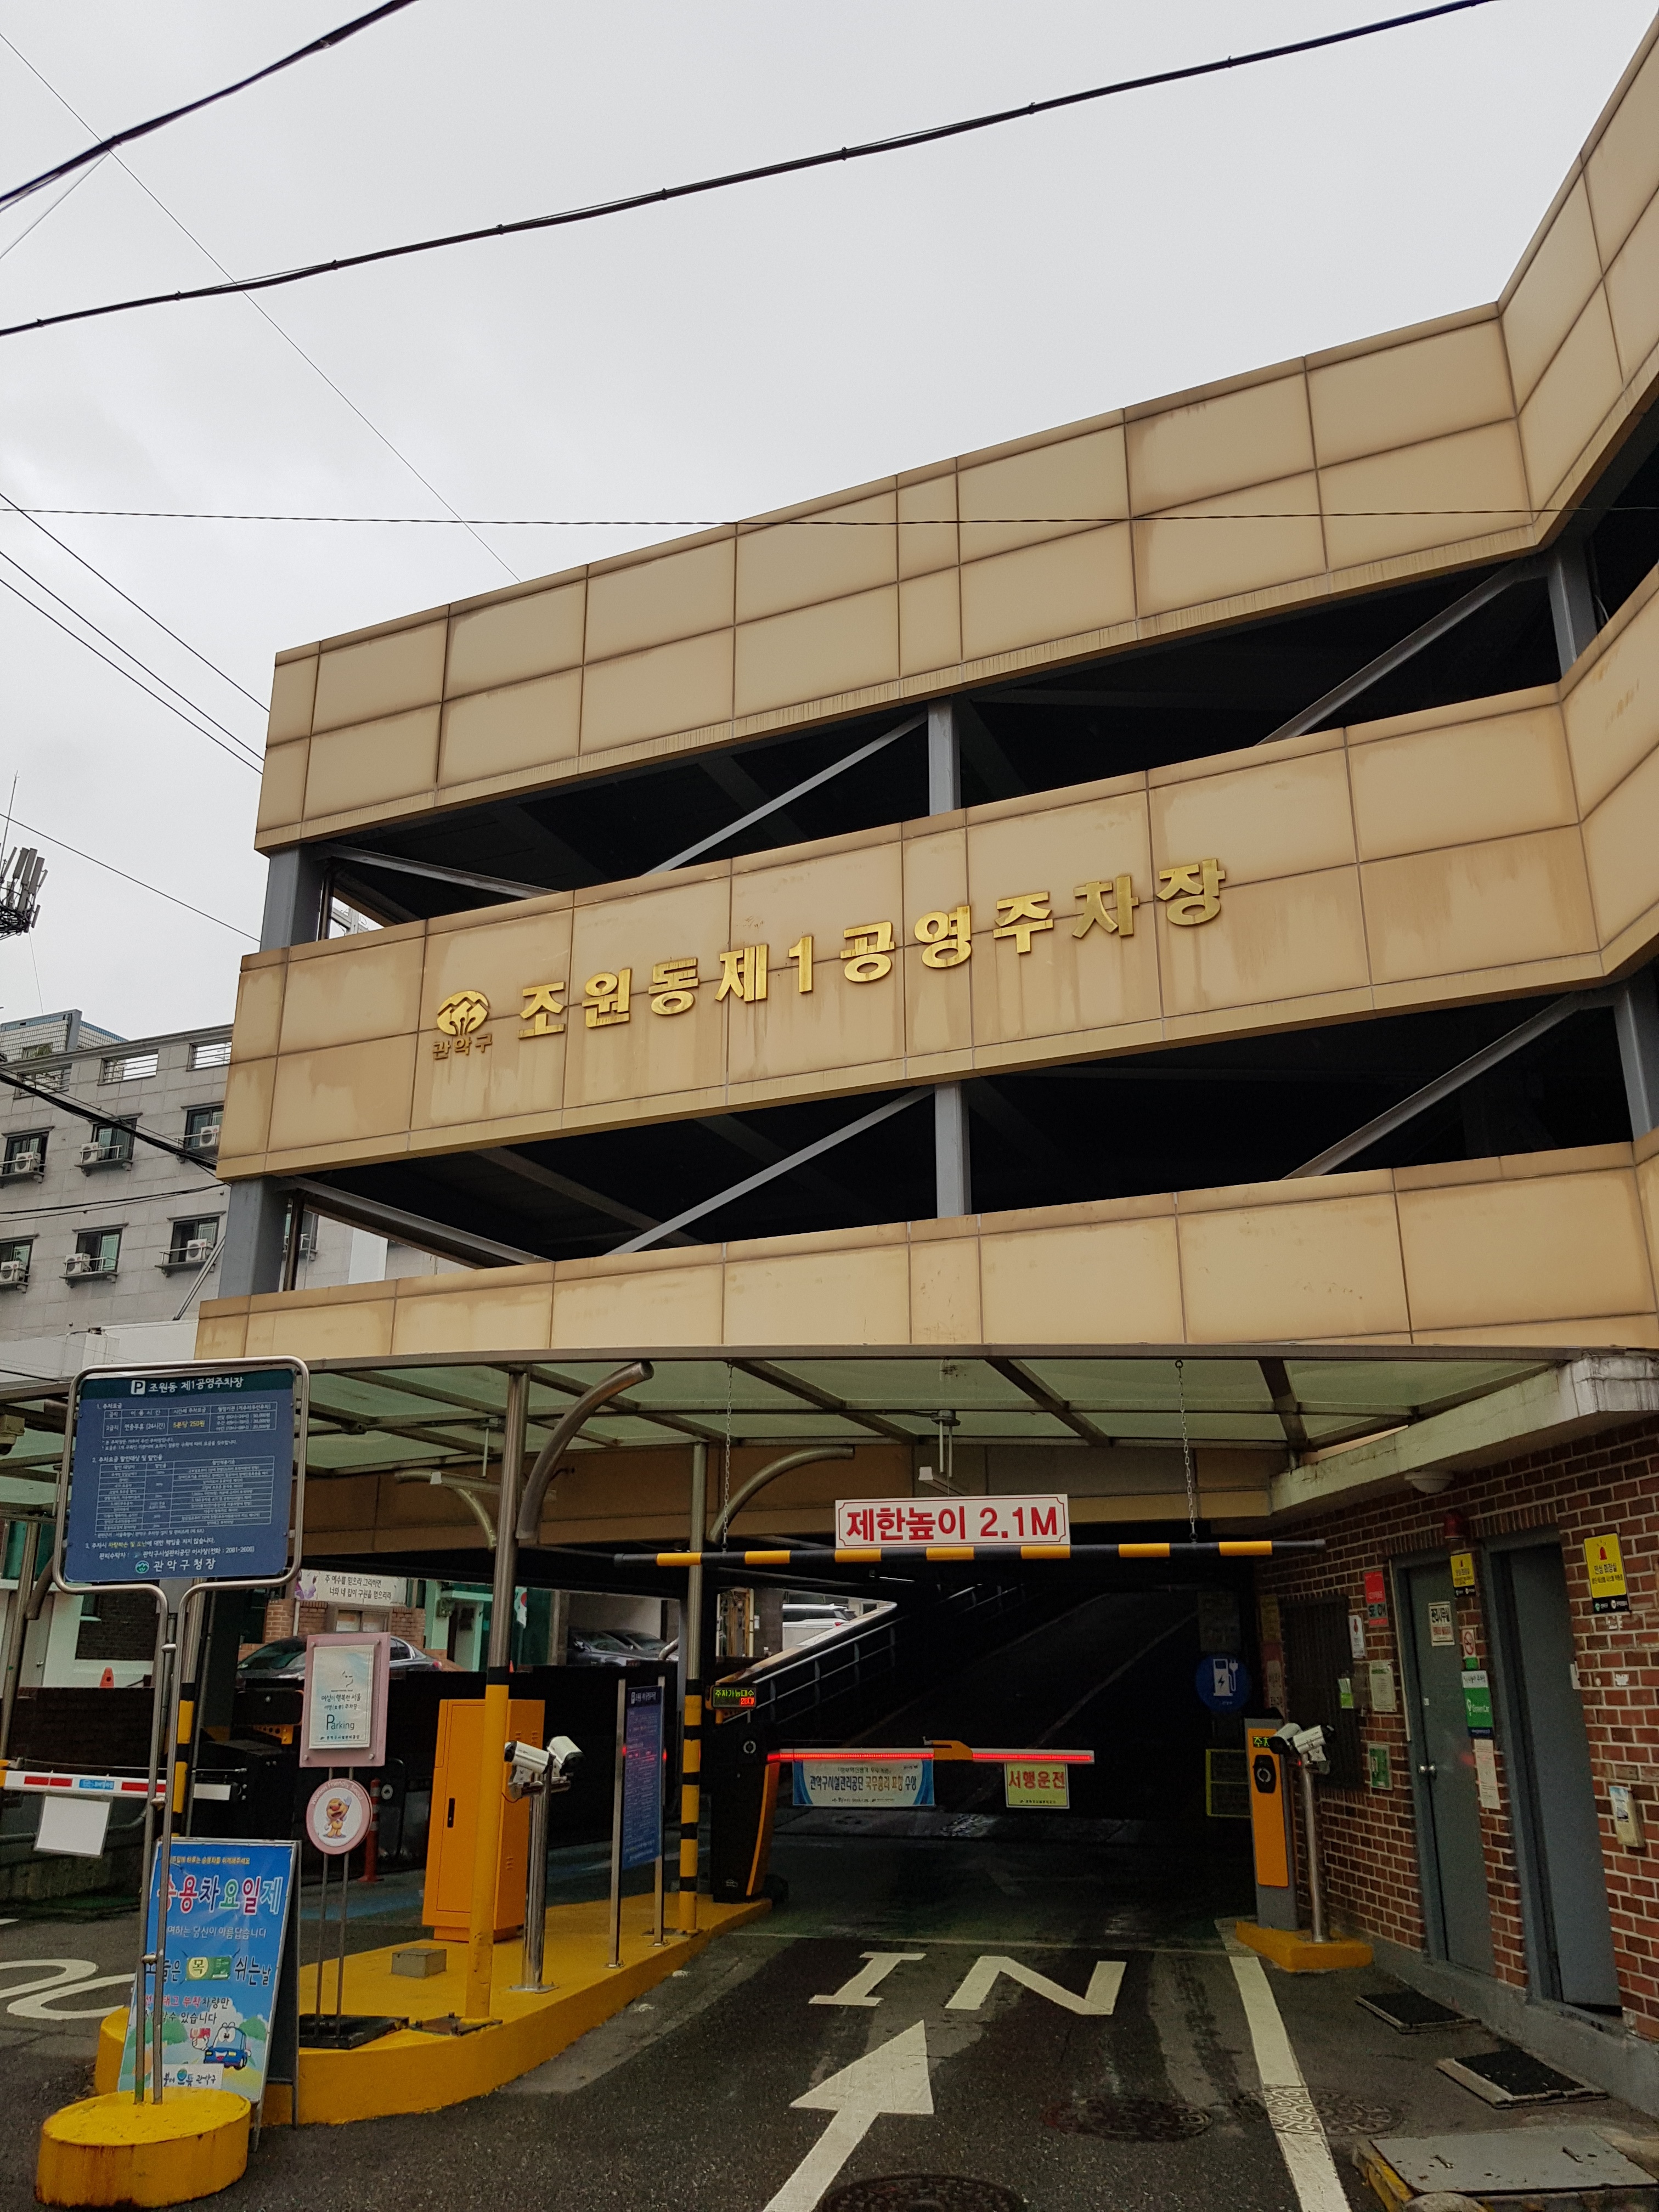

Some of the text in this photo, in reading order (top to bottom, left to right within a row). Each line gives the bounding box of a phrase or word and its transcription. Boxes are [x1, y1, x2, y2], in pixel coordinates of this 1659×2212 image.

[433, 1034, 493, 1060] 관악구
[148, 1382, 178, 1393] 조원동
[180, 1377, 244, 1390] 제1공영주차장
[847, 1505, 1058, 1542] 제한높이 2.1M
[325, 1575, 330, 1583] 주
[331, 1575, 346, 1585] 예수를
[351, 1693, 362, 1701] 서울
[326, 1714, 355, 1731] Parking
[810, 1775, 864, 1791] 관악구시설관리공단
[1008, 1770, 1065, 1790] 서행운전
[167, 1925, 267, 1940] 여하는 당신이 아름답습니다
[192, 1959, 205, 1974] 목
[234, 1954, 272, 1987] 쉬는날
[808, 1951, 1127, 2016] IN
[181, 2011, 217, 2025] 있습니다
